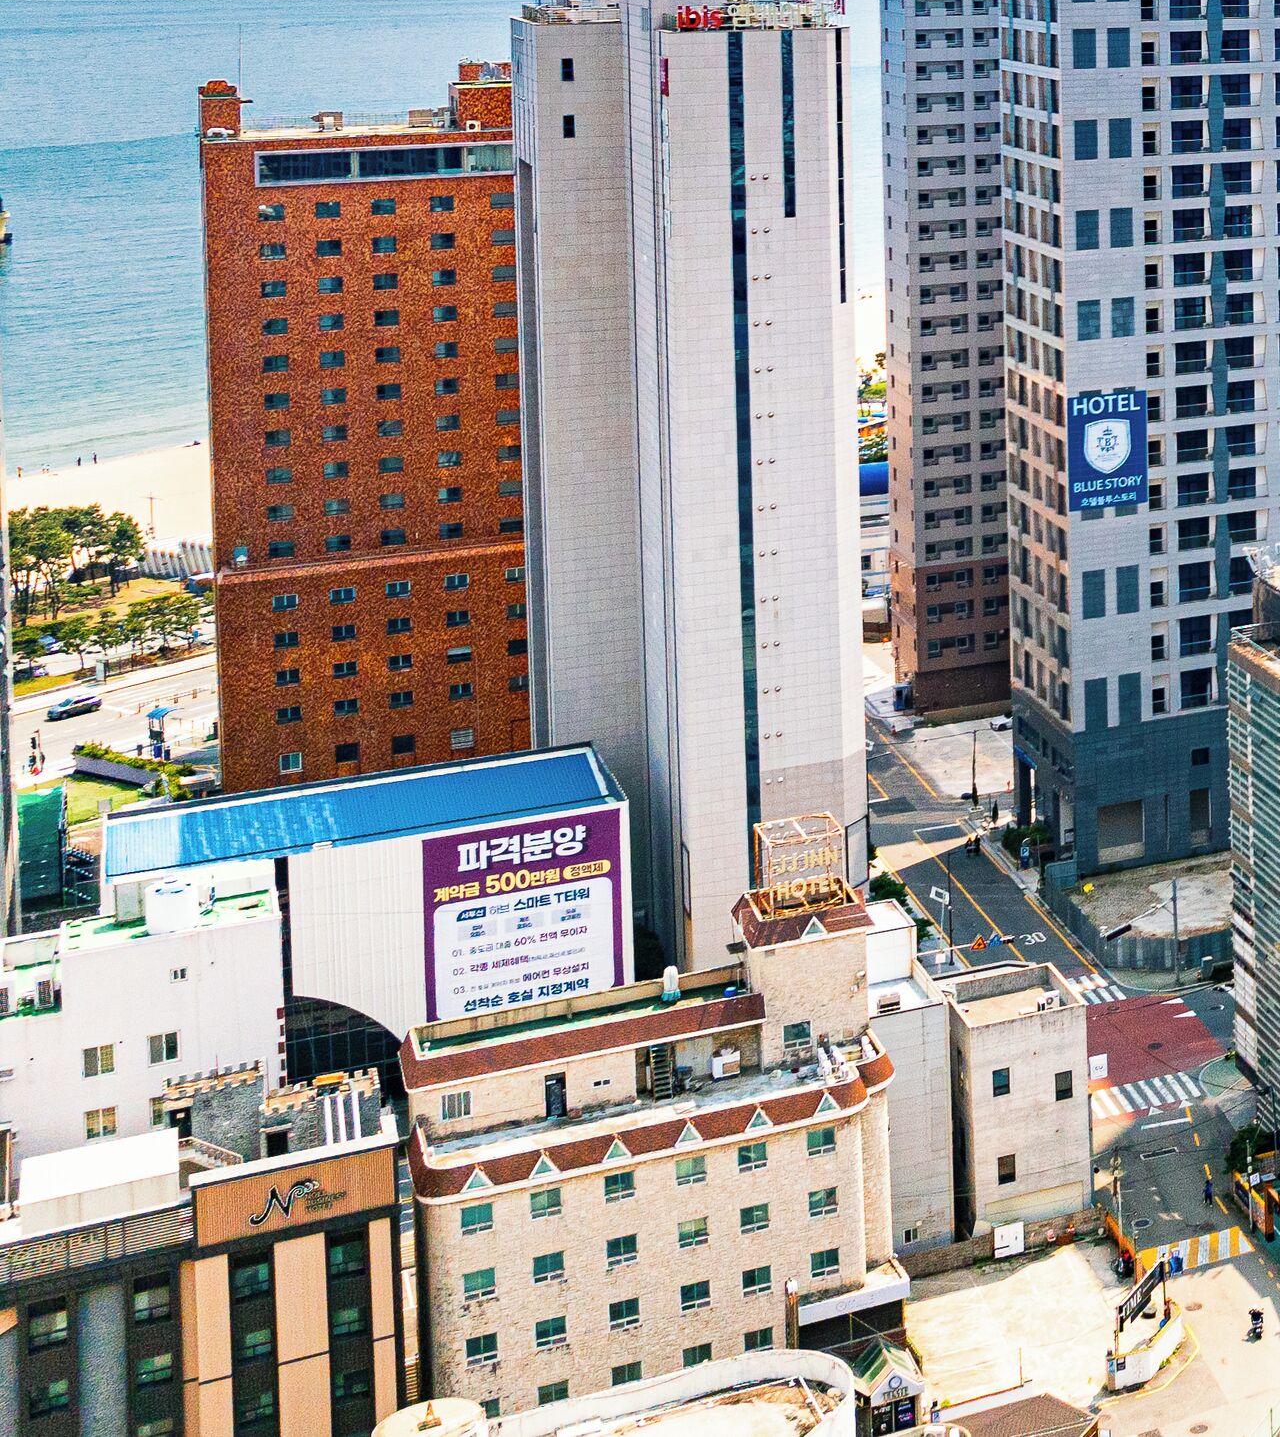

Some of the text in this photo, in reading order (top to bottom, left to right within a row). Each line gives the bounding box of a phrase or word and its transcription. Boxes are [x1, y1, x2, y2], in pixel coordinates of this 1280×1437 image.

[677, 5, 725, 29] ibis
[1073, 394, 1140, 416] HOTEL
[1073, 475, 1143, 494] BLUE STORY
[457, 824, 587, 872] 파격분양
[433, 861, 604, 903] 계약금 500만원 정액제
[776, 872, 840, 901] HOTEL
[513, 894, 551, 911] 스마트
[553, 887, 590, 905] T타워
[513, 936, 536, 947] 60%
[1019, 931, 1047, 946] 30
[463, 995, 503, 1013] 선착순
[507, 989, 533, 1004] 호실
[538, 978, 590, 997] 지정계약
